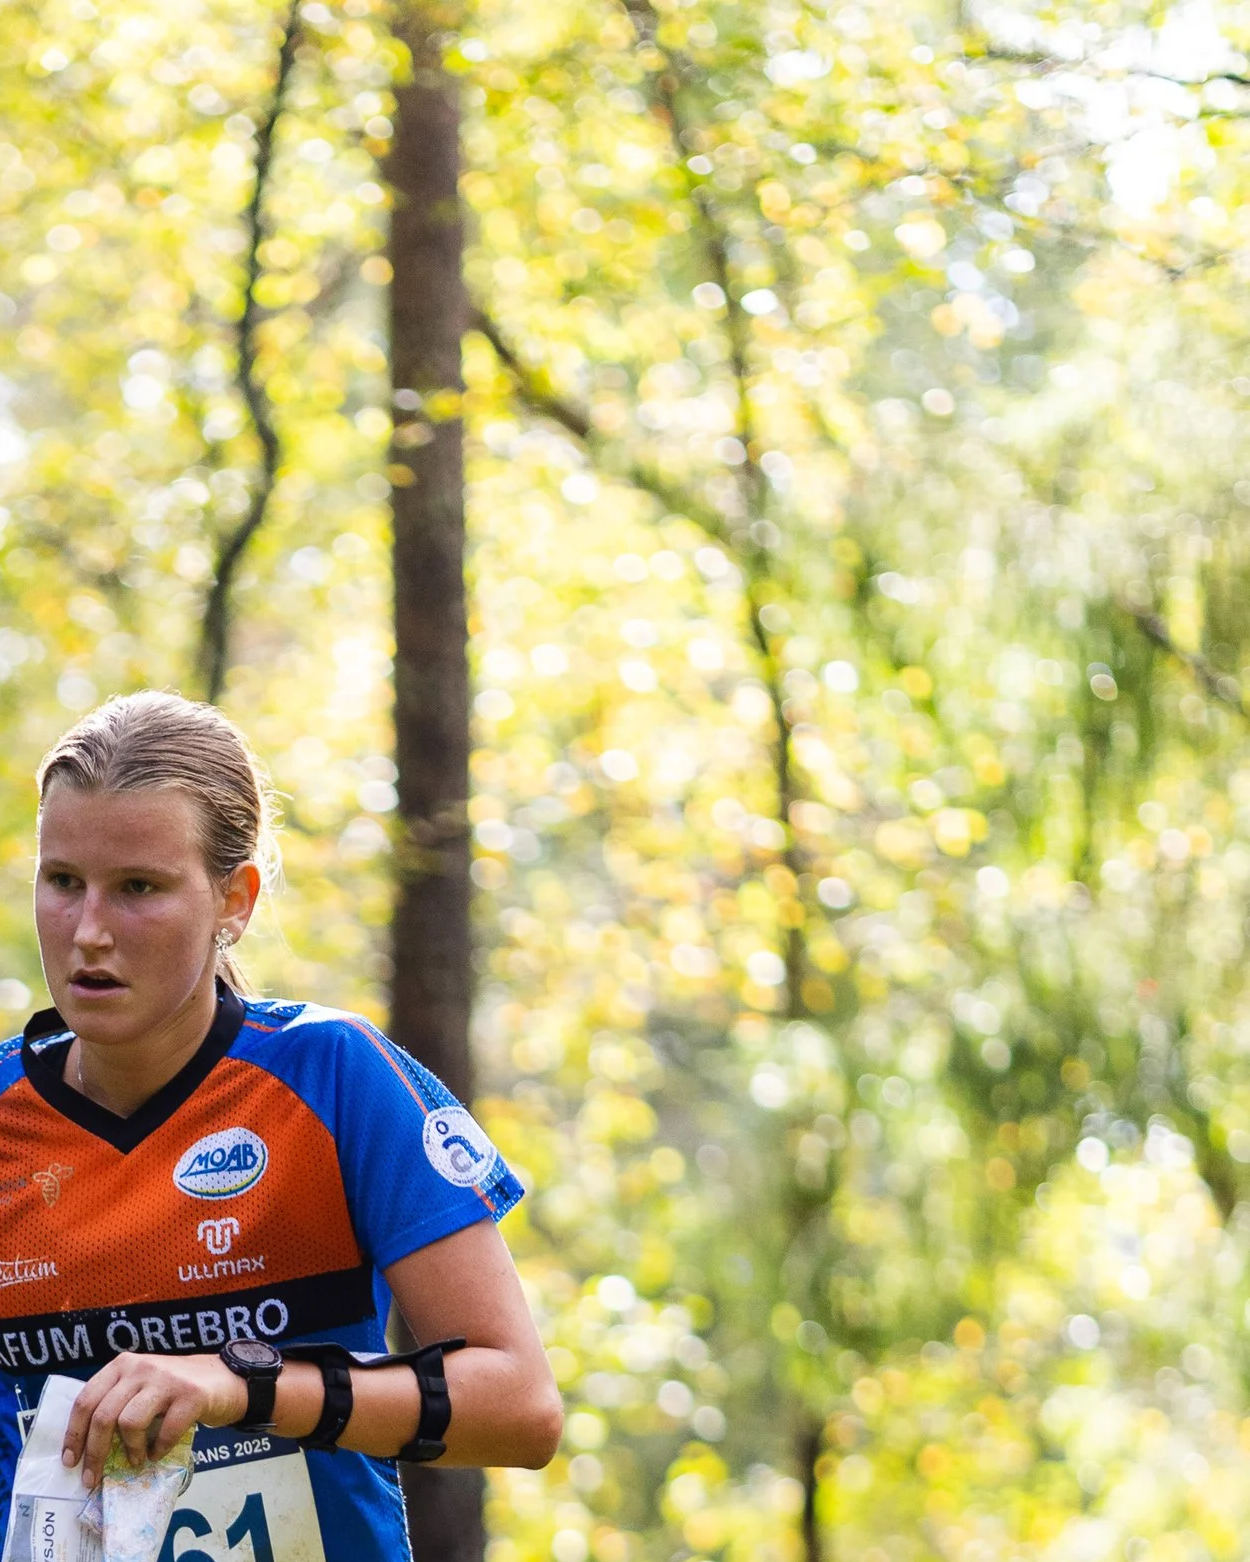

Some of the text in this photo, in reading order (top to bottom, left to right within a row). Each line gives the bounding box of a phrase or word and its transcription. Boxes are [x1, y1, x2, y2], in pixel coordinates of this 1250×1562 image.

[180, 1143, 258, 1178] MOAB
[178, 1255, 265, 1281] ULLMAX
[106, 1298, 289, 1353] ÖREBRO
[191, 1437, 271, 1465] ANS 2025
